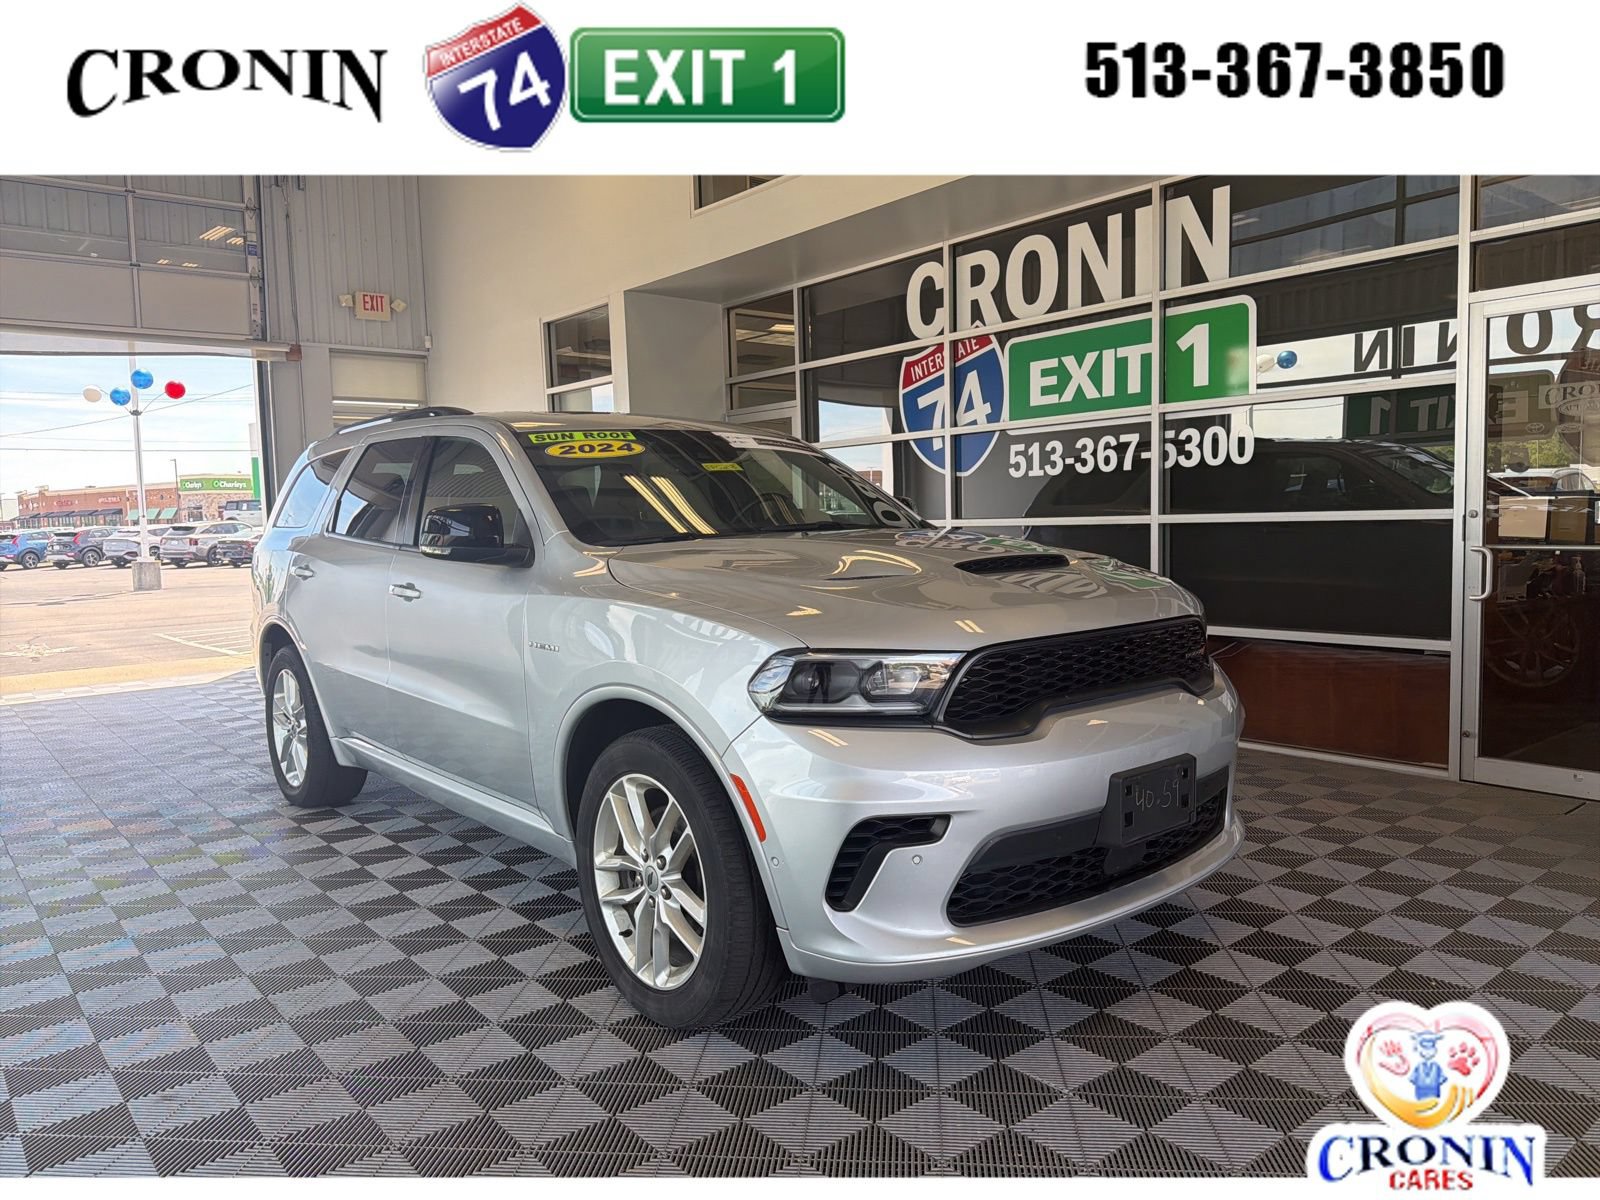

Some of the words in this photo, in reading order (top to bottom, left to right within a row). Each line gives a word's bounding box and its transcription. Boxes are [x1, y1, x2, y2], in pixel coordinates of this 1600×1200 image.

[906, 184, 1231, 340] CRONIN
[362, 294, 385, 312] EXIT
[910, 337, 980, 382] INTERATE
[1029, 341, 1152, 407] EXIT
[1176, 322, 1210, 387] 1
[916, 369, 993, 451] 74
[1545, 382, 1600, 406] CRO
[534, 432, 574, 442] SUN
[582, 430, 631, 440] ROOF
[558, 442, 635, 456] 2024
[1008, 422, 1255, 480] 513-367-5300
